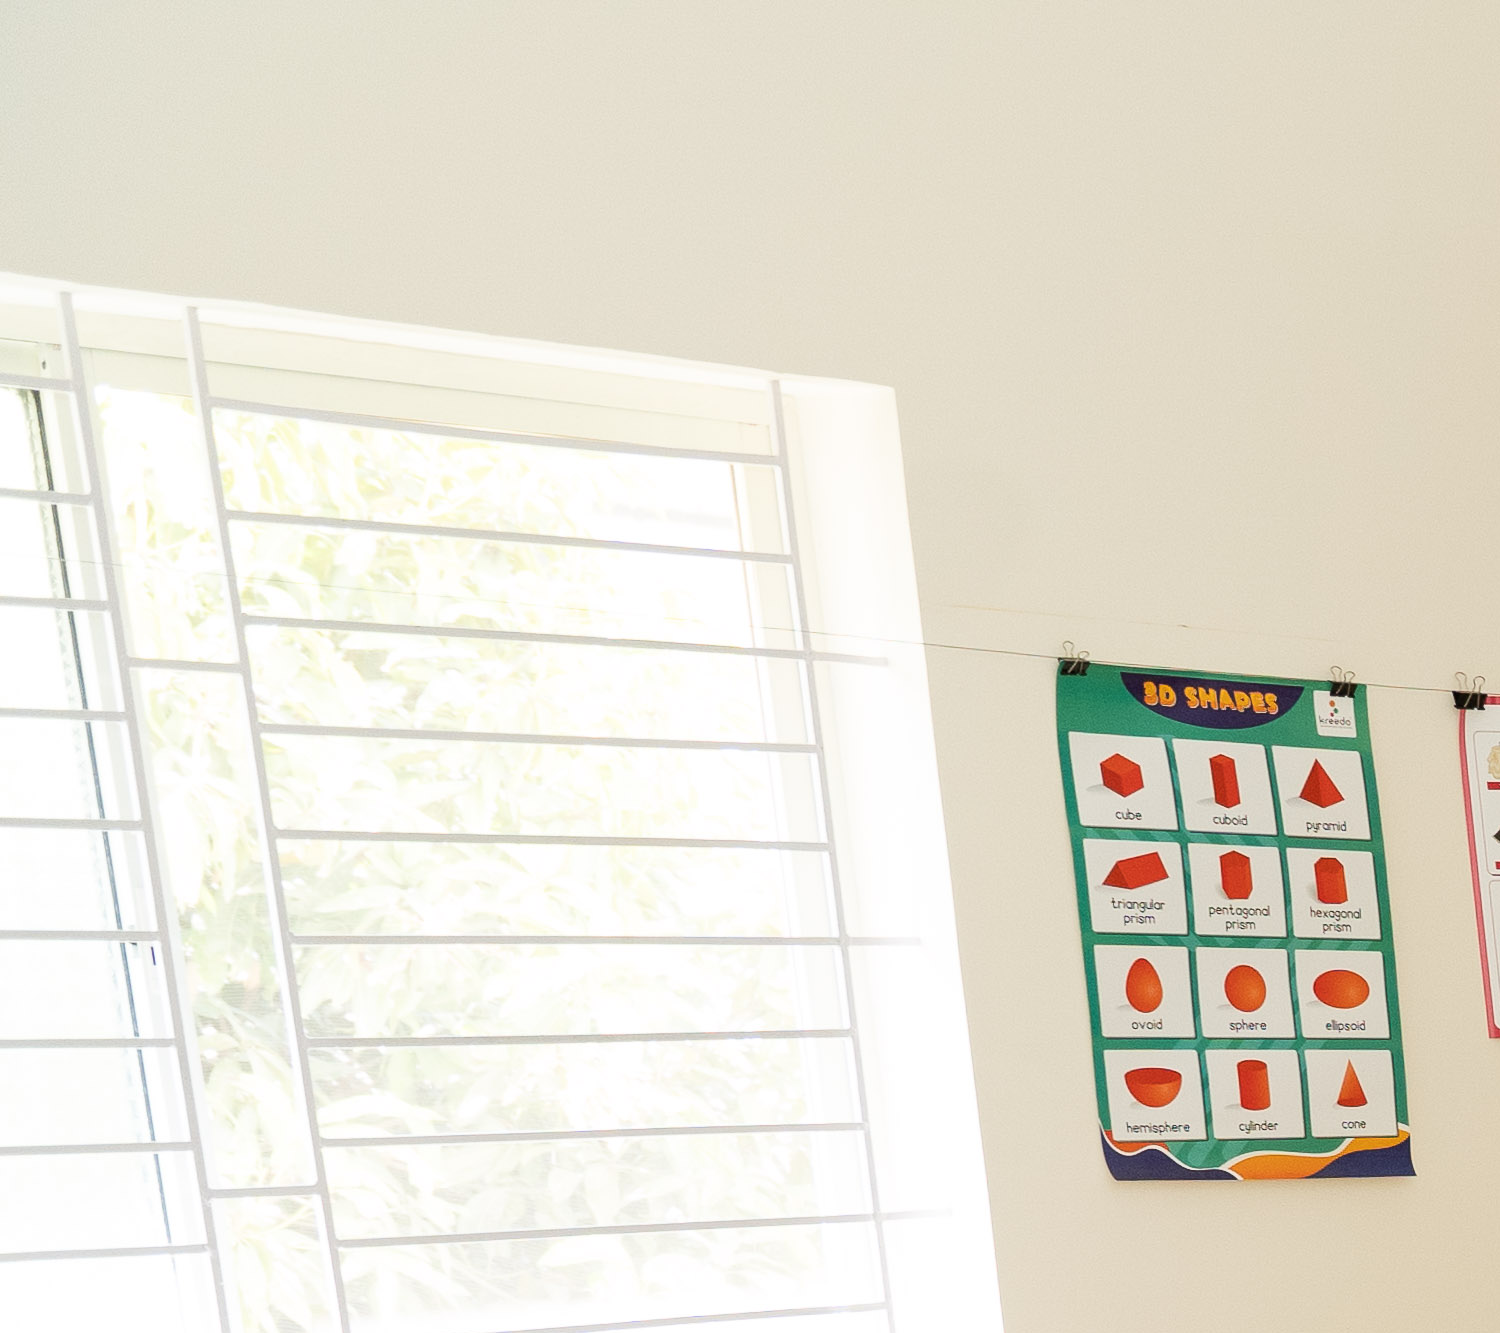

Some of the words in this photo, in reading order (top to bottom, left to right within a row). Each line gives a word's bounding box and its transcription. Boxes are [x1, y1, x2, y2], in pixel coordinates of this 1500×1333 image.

[1143, 681, 1177, 708] 3D
[1183, 685, 1279, 715] SHAPES
[1115, 809, 1142, 822] cube
[1212, 814, 1248, 827] cuboid
[1305, 820, 1347, 833] pyramid
[1111, 896, 1165, 912] triangular
[1209, 904, 1271, 918] pentagonal
[1310, 906, 1362, 921] hexagonal
[1123, 912, 1156, 926] prism
[1225, 919, 1256, 932] prism
[1322, 921, 1352, 934] prism
[1131, 1019, 1163, 1031] ovoid
[1229, 1020, 1267, 1033] sphere
[1325, 1019, 1366, 1033] ellipsoid
[1125, 1121, 1190, 1134] hemisphere
[1238, 1120, 1279, 1134] cylinder
[1341, 1119, 1367, 1130] cone
